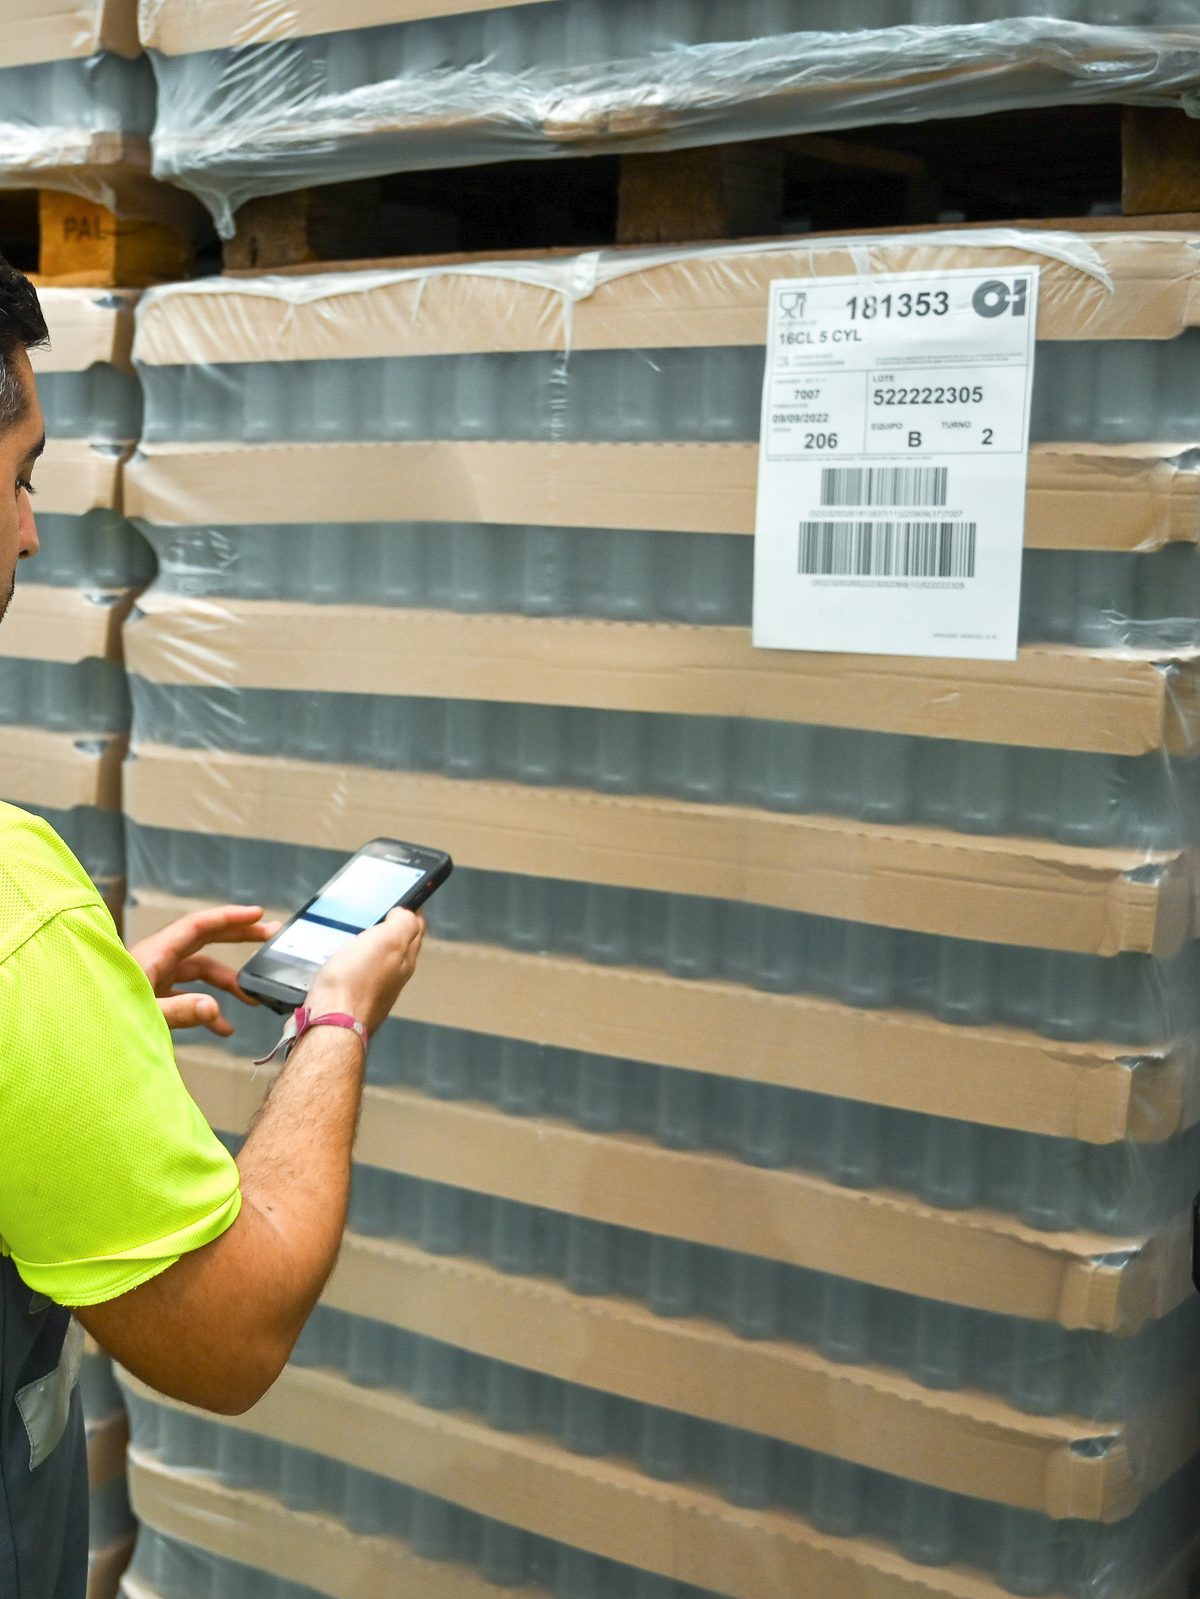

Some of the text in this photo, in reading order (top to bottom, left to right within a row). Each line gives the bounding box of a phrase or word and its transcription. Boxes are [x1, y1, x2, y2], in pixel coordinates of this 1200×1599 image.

[846, 290, 950, 320] 181353
[779, 328, 863, 345] 16CL 5 CYL
[872, 374, 895, 383] LOTE
[793, 388, 821, 400] 7007
[872, 386, 984, 406] 522222305
[771, 412, 830, 424] 09/09/2022
[871, 420, 972, 431] EQUIPO TURNO
[803, 428, 994, 450] 206 B 2
